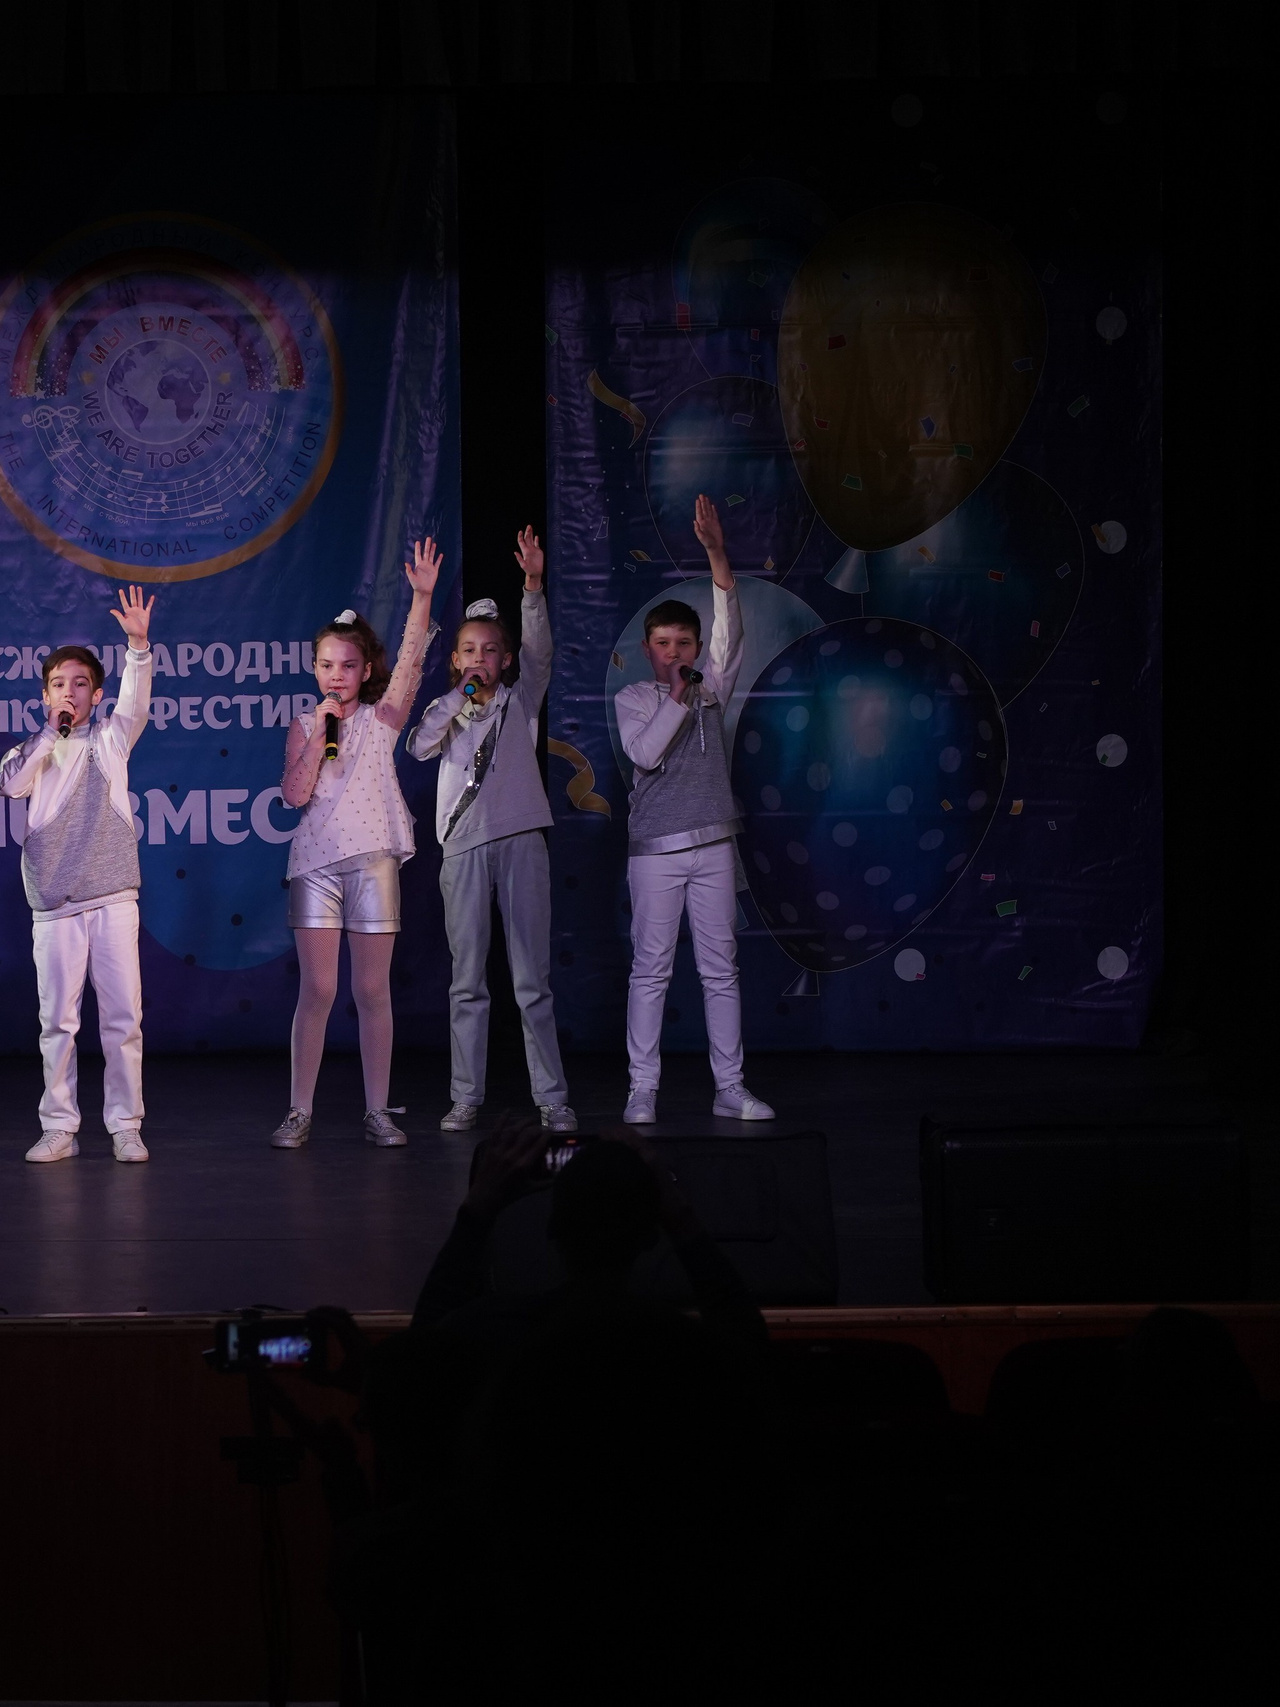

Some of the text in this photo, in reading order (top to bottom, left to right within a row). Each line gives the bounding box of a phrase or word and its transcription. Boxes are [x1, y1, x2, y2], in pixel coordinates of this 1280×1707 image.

[88, 314, 228, 365] МЫ ВМЕСТЕ
[81, 390, 233, 469] WE ARE TOGETHER
[36, 493, 198, 557] INTERNATIONAL
[223, 421, 323, 541] COMPETITION
